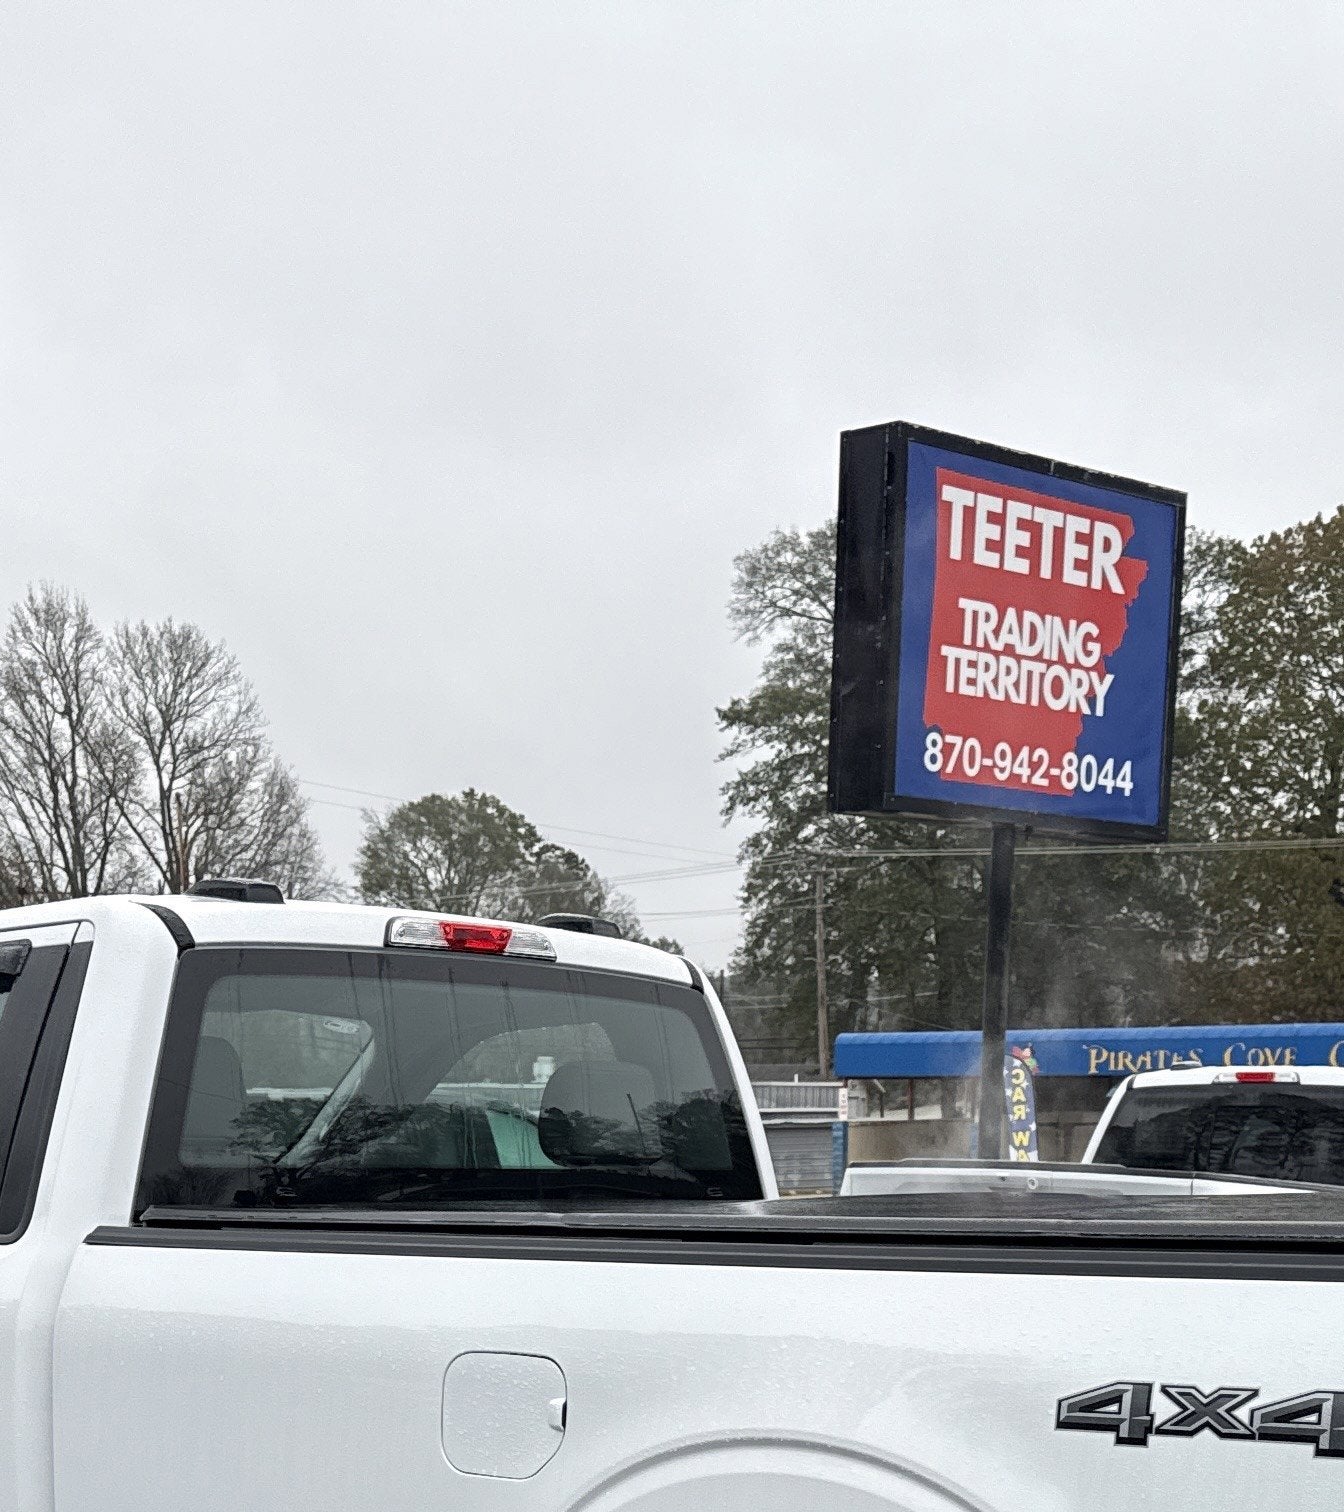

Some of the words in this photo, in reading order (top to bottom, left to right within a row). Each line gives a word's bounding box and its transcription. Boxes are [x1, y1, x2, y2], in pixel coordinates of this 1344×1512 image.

[942, 485, 1125, 595] TEETER
[958, 597, 1102, 667] TRADING
[941, 645, 1115, 717] TERRITORY
[923, 731, 1134, 796] 870-942-8044
